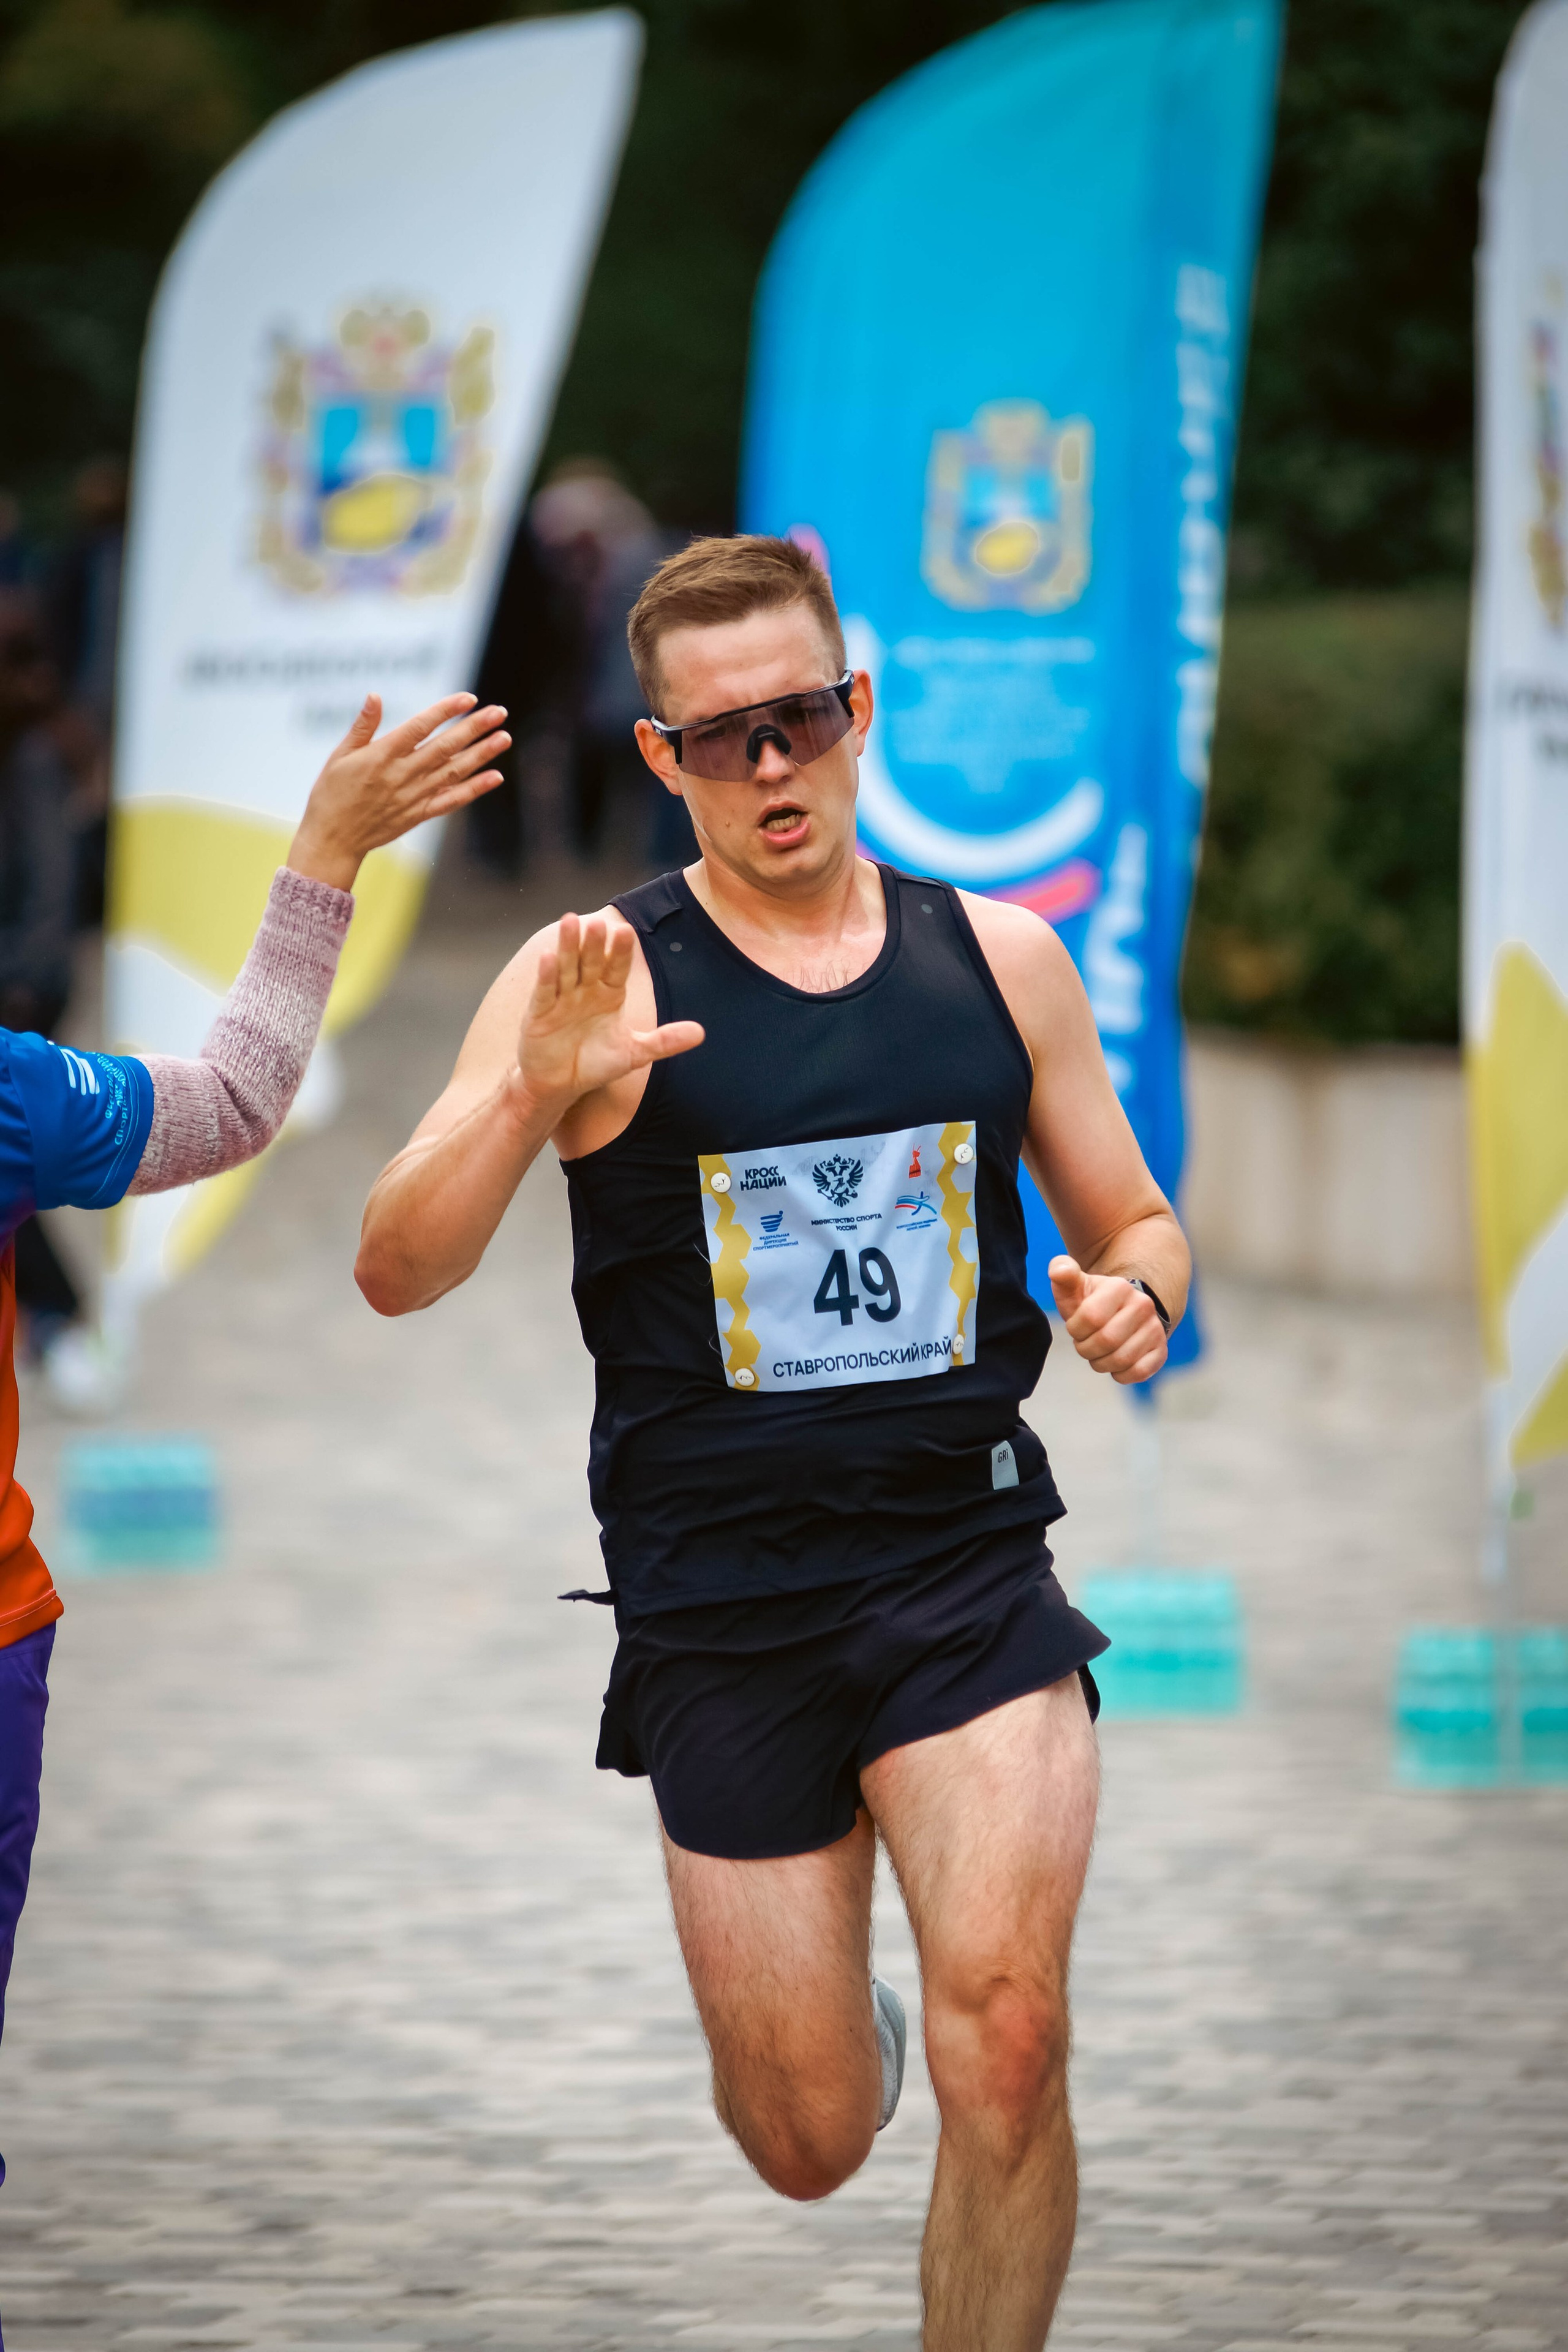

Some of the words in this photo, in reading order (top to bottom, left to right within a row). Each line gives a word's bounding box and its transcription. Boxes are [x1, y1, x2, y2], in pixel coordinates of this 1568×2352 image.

[740, 1176, 786, 1191] НАЦИИ
[745, 1166, 779, 1180] КРОСС
[813, 1247, 901, 1326] 49
[773, 1343, 920, 1378] СТАВРОПОЛЬСКИЙ
[921, 1336, 952, 1360] КРАЙ
